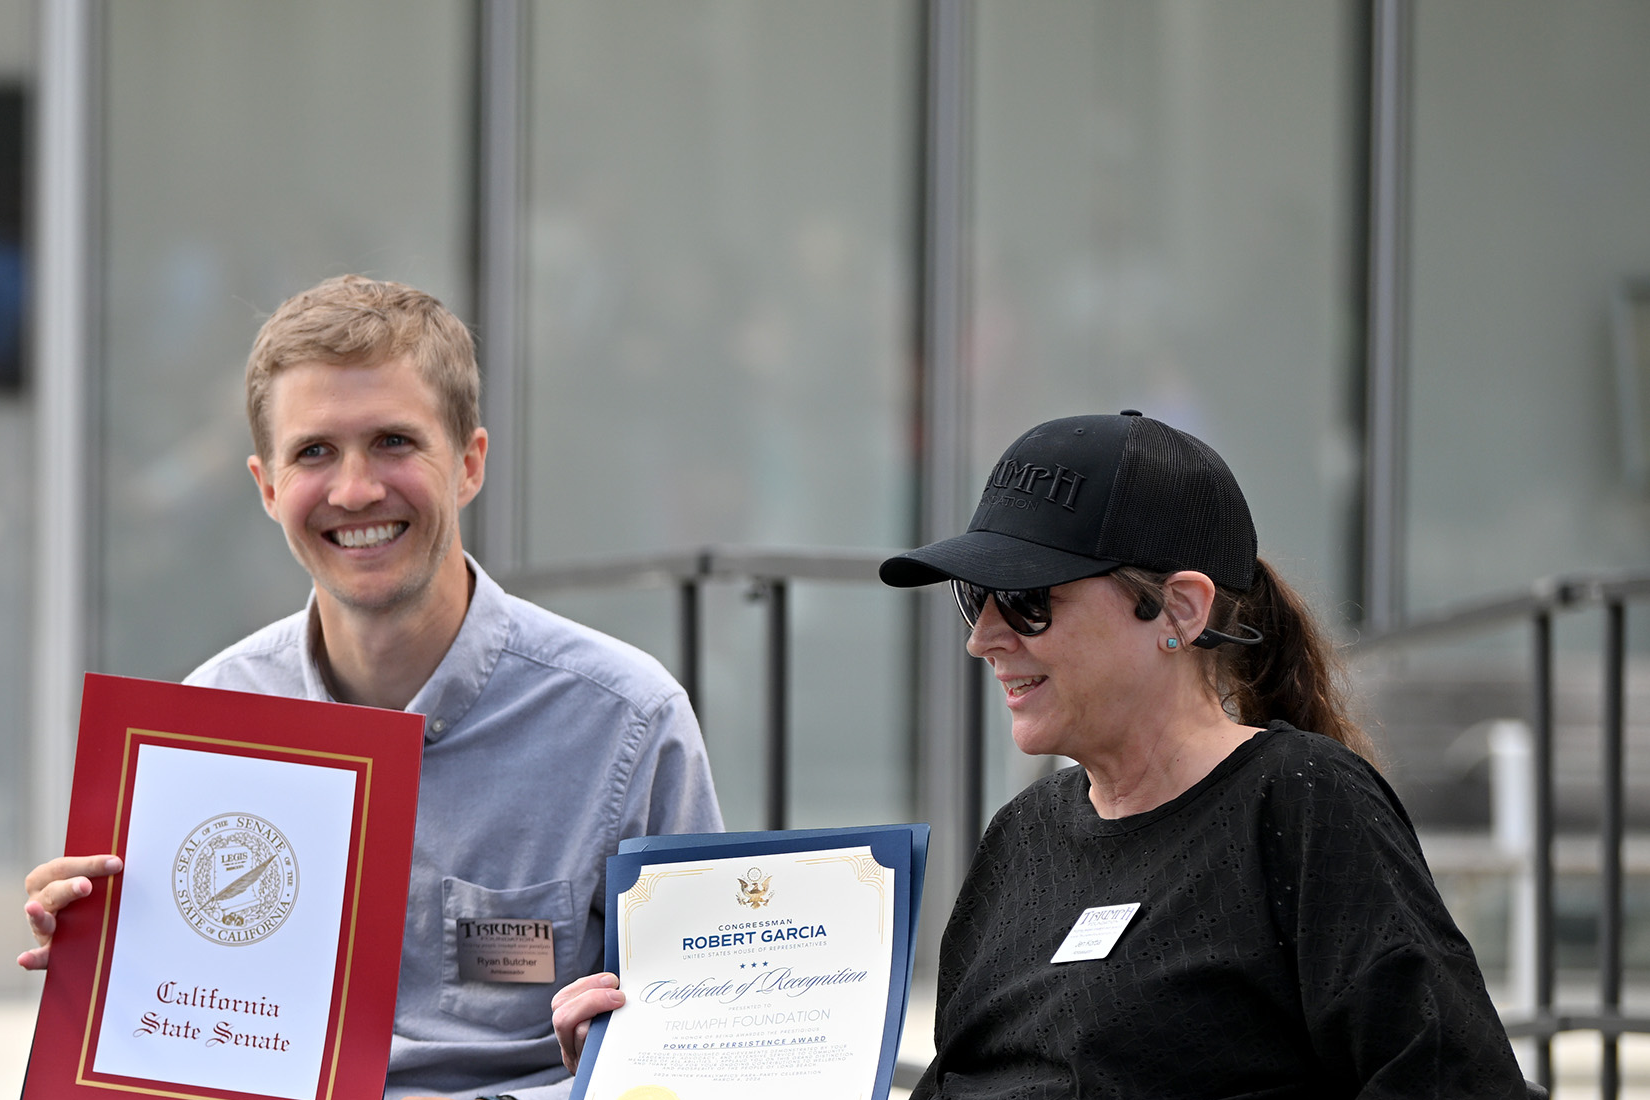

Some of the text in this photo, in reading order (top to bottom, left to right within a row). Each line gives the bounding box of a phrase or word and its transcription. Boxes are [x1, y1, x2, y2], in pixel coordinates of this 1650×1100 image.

[177, 839, 201, 873] SEAL
[202, 827, 211, 836] OF
[213, 820, 229, 830] THE
[236, 817, 286, 853] SENATE
[221, 851, 248, 864] LEGIS
[178, 889, 291, 942] STATE OF CALIFORNIA
[718, 918, 793, 932] CONGRESSMAN
[1080, 907, 1135, 925] TRIUMPH
[460, 921, 550, 940] TRIUMPH
[682, 924, 827, 951] ROBERT GARCIA
[682, 951, 705, 960] UNITED
[708, 950, 731, 958] STATES
[733, 947, 755, 955] HOUSE
[769, 940, 827, 952] REPRESENTATIVES
[477, 957, 537, 968] Ryan Butcher
[639, 977, 733, 1009] Certificate
[756, 966, 868, 998] Recognition
[156, 980, 281, 1017] California
[664, 1008, 831, 1031] TRIUMPH FOUNDATION
[133, 1011, 291, 1052] State Senate
[719, 1038, 787, 1049] PERSISTENCE
[790, 1035, 826, 1044] AWARD
